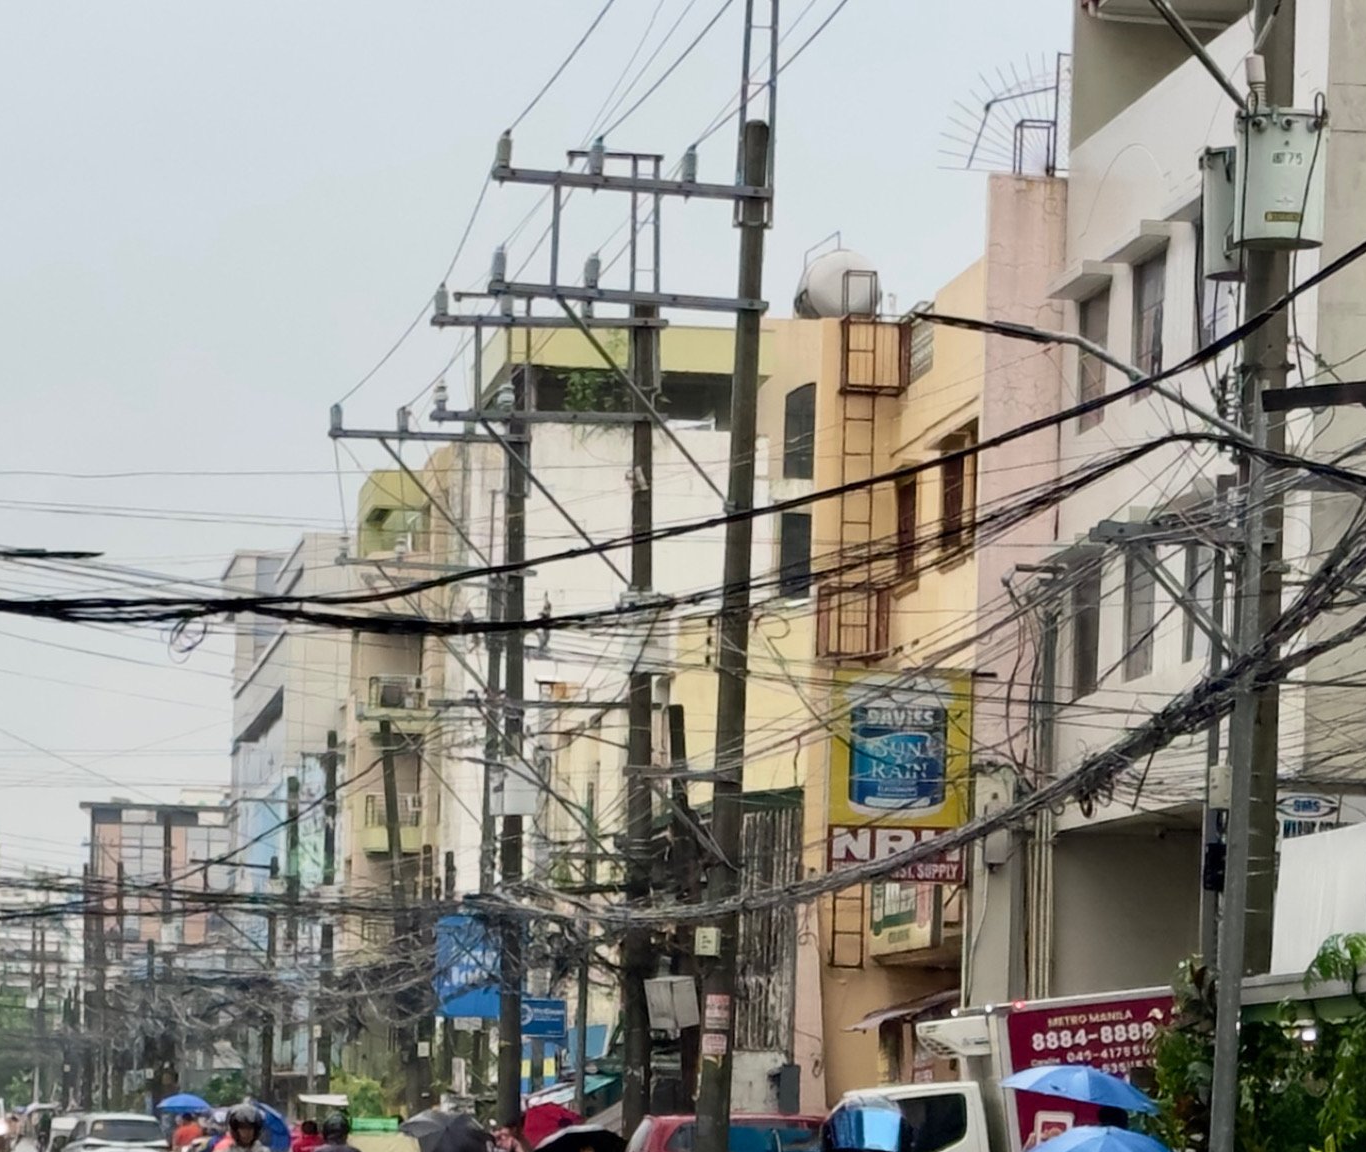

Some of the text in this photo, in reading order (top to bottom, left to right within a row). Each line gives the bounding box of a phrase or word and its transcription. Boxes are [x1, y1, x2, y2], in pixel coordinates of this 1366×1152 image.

[874, 737, 923, 758] SUN
[871, 761, 928, 779] RAIN
[917, 862, 959, 880] SUPPLY
[1047, 1009, 1133, 1028] METRO MANILA
[1031, 1021, 1158, 1052] 8884-8888
